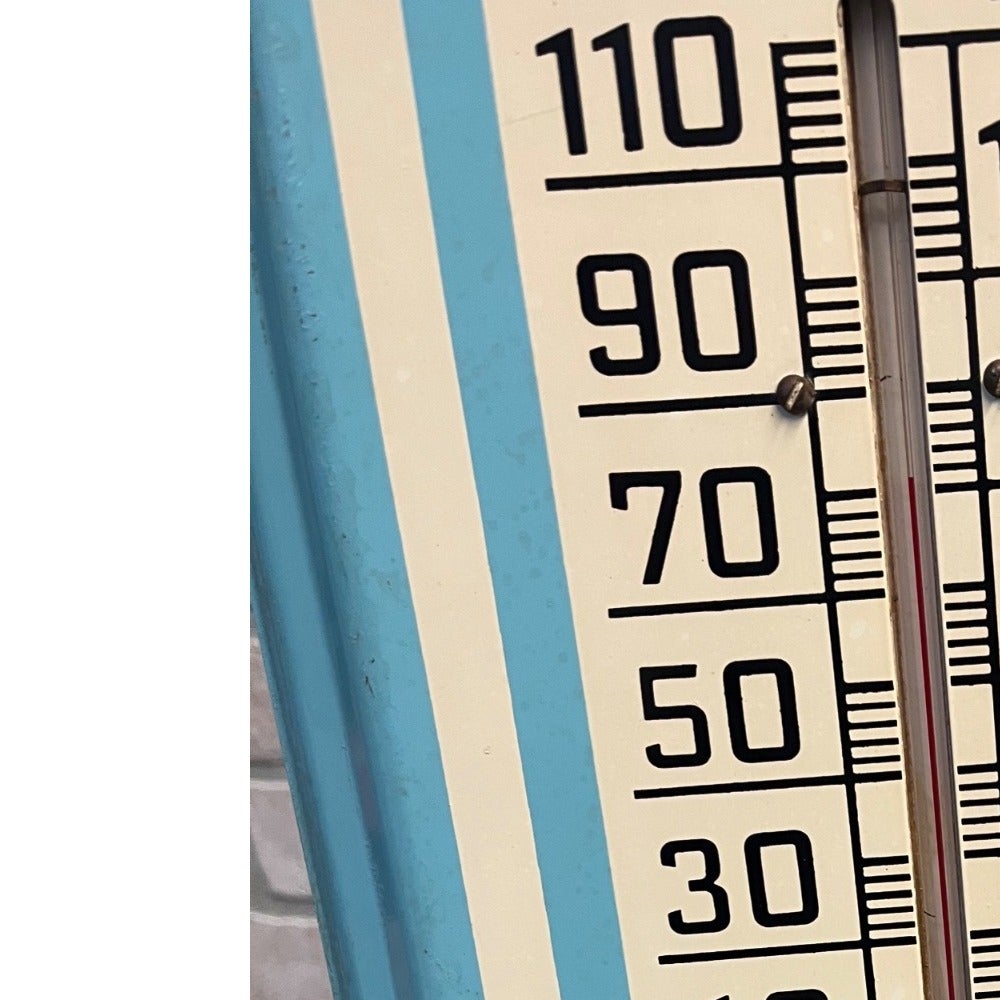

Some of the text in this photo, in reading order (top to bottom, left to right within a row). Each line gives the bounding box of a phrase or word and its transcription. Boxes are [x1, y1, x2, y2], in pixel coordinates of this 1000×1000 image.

[535, 15, 743, 156] 110
[576, 248, 758, 377] 90
[608, 465, 780, 585] 70
[638, 658, 801, 769] 50
[659, 829, 820, 935] 30
